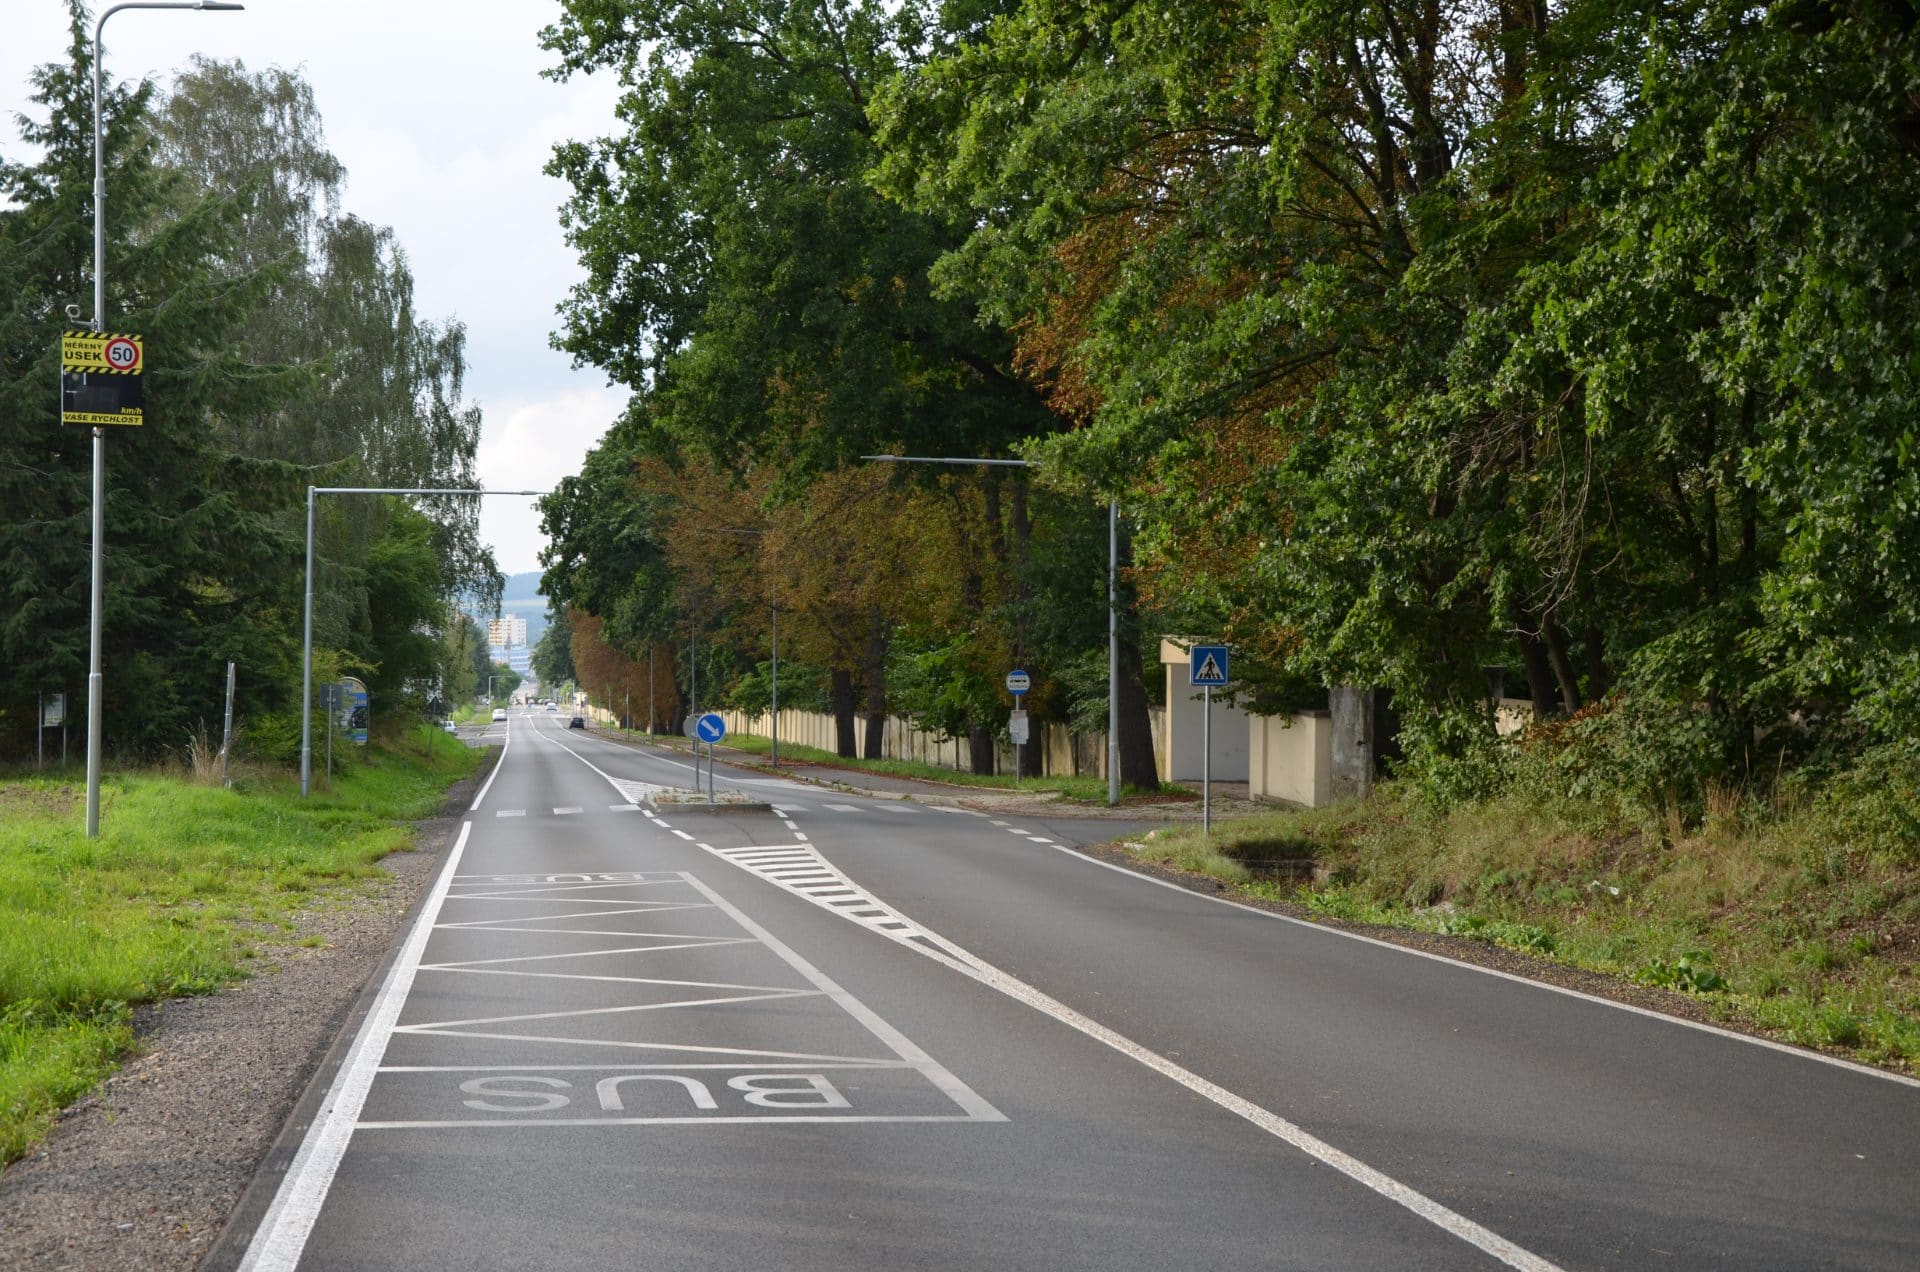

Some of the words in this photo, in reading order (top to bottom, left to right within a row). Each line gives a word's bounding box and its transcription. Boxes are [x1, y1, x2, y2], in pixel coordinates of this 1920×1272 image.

[65, 349, 102, 361] ÚSEK
[112, 348, 132, 362] 50
[121, 407, 142, 415] km/h
[65, 413, 89, 421] VAŠE
[91, 415, 139, 423] RYCHLOST
[460, 1074, 853, 1112] BUS
